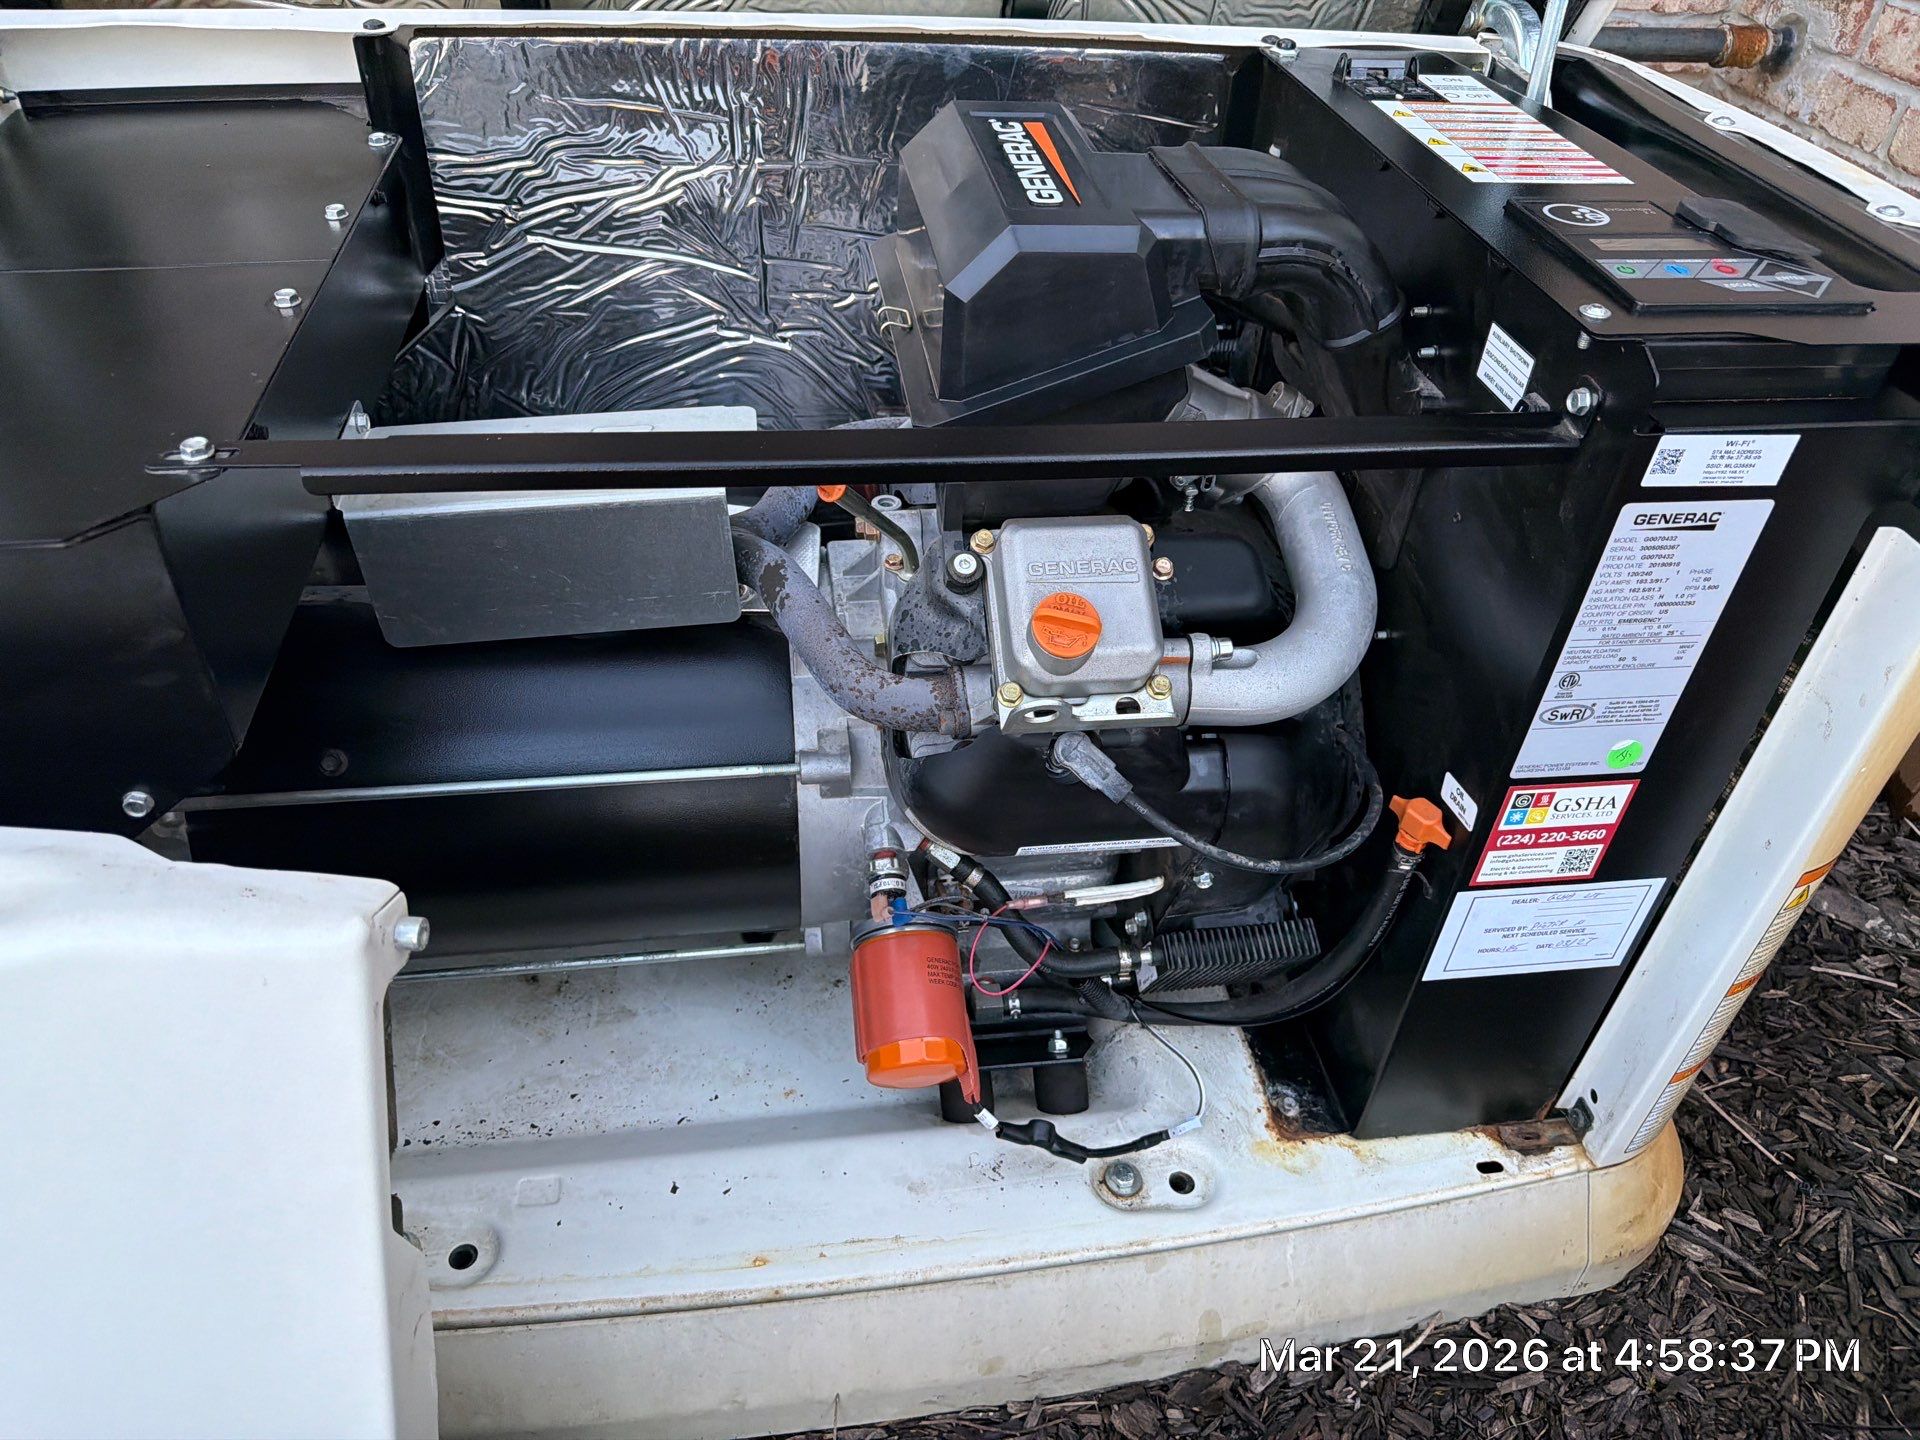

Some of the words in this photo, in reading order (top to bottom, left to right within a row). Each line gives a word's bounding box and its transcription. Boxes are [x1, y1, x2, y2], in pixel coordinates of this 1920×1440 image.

[988, 119, 1064, 204] GENERAC
[1633, 512, 1722, 526] GENERAC
[1027, 558, 1138, 576] GENERAC
[1626, 570, 1653, 578] 120/240
[1589, 595, 1631, 603] INSULATION
[1584, 603, 1633, 611] CONTROLLER
[1581, 610, 1617, 618] COUNTRY
[1627, 609, 1653, 617] ORIGIN
[1617, 617, 1663, 625] EMERGENCY
[1547, 708, 1588, 721] SwRI
[1450, 791, 1467, 815] DRAIN
[1553, 795, 1617, 812] GSHA
[1595, 810, 1613, 818] LTD
[1496, 833, 1535, 848] (224)
[1537, 829, 1607, 843] 220-3660
[1480, 870, 1503, 878] Heating
[1518, 867, 1554, 876] Conditioning
[1483, 926, 1516, 934] SERVICED
[1520, 930, 1558, 938] SCHEDULED
